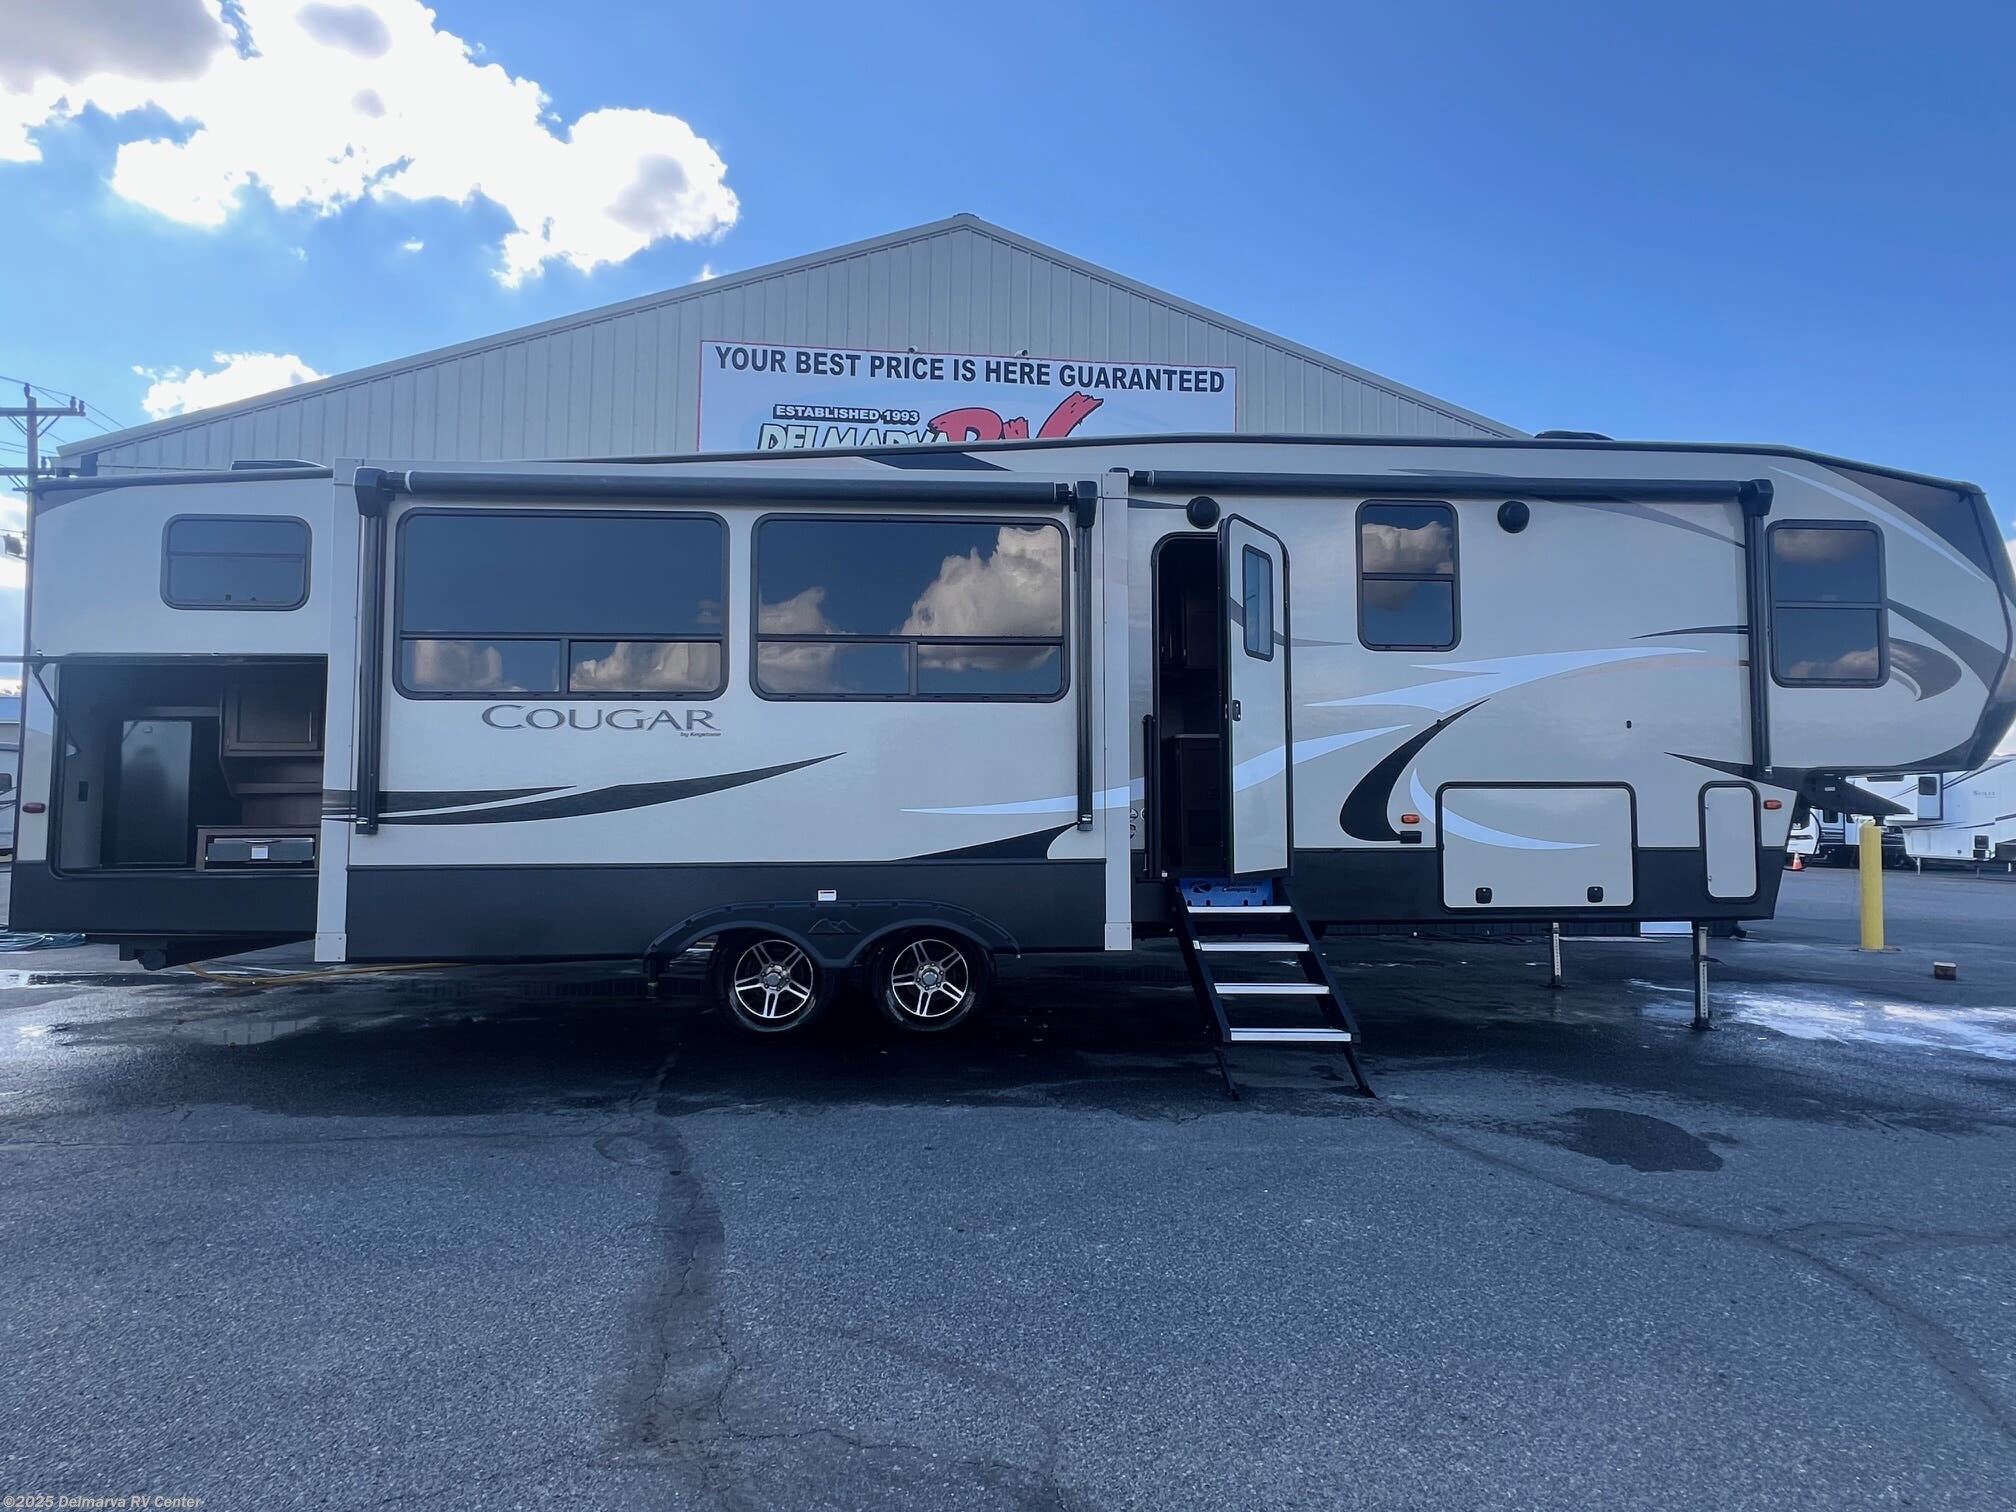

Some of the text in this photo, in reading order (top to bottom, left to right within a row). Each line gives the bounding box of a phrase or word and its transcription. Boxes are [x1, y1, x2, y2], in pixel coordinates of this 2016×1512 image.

[715, 345, 1226, 393] YOUR BEST PRICE IS HERE GUARANTEED
[775, 405, 921, 424] ESTABLISHED 1993
